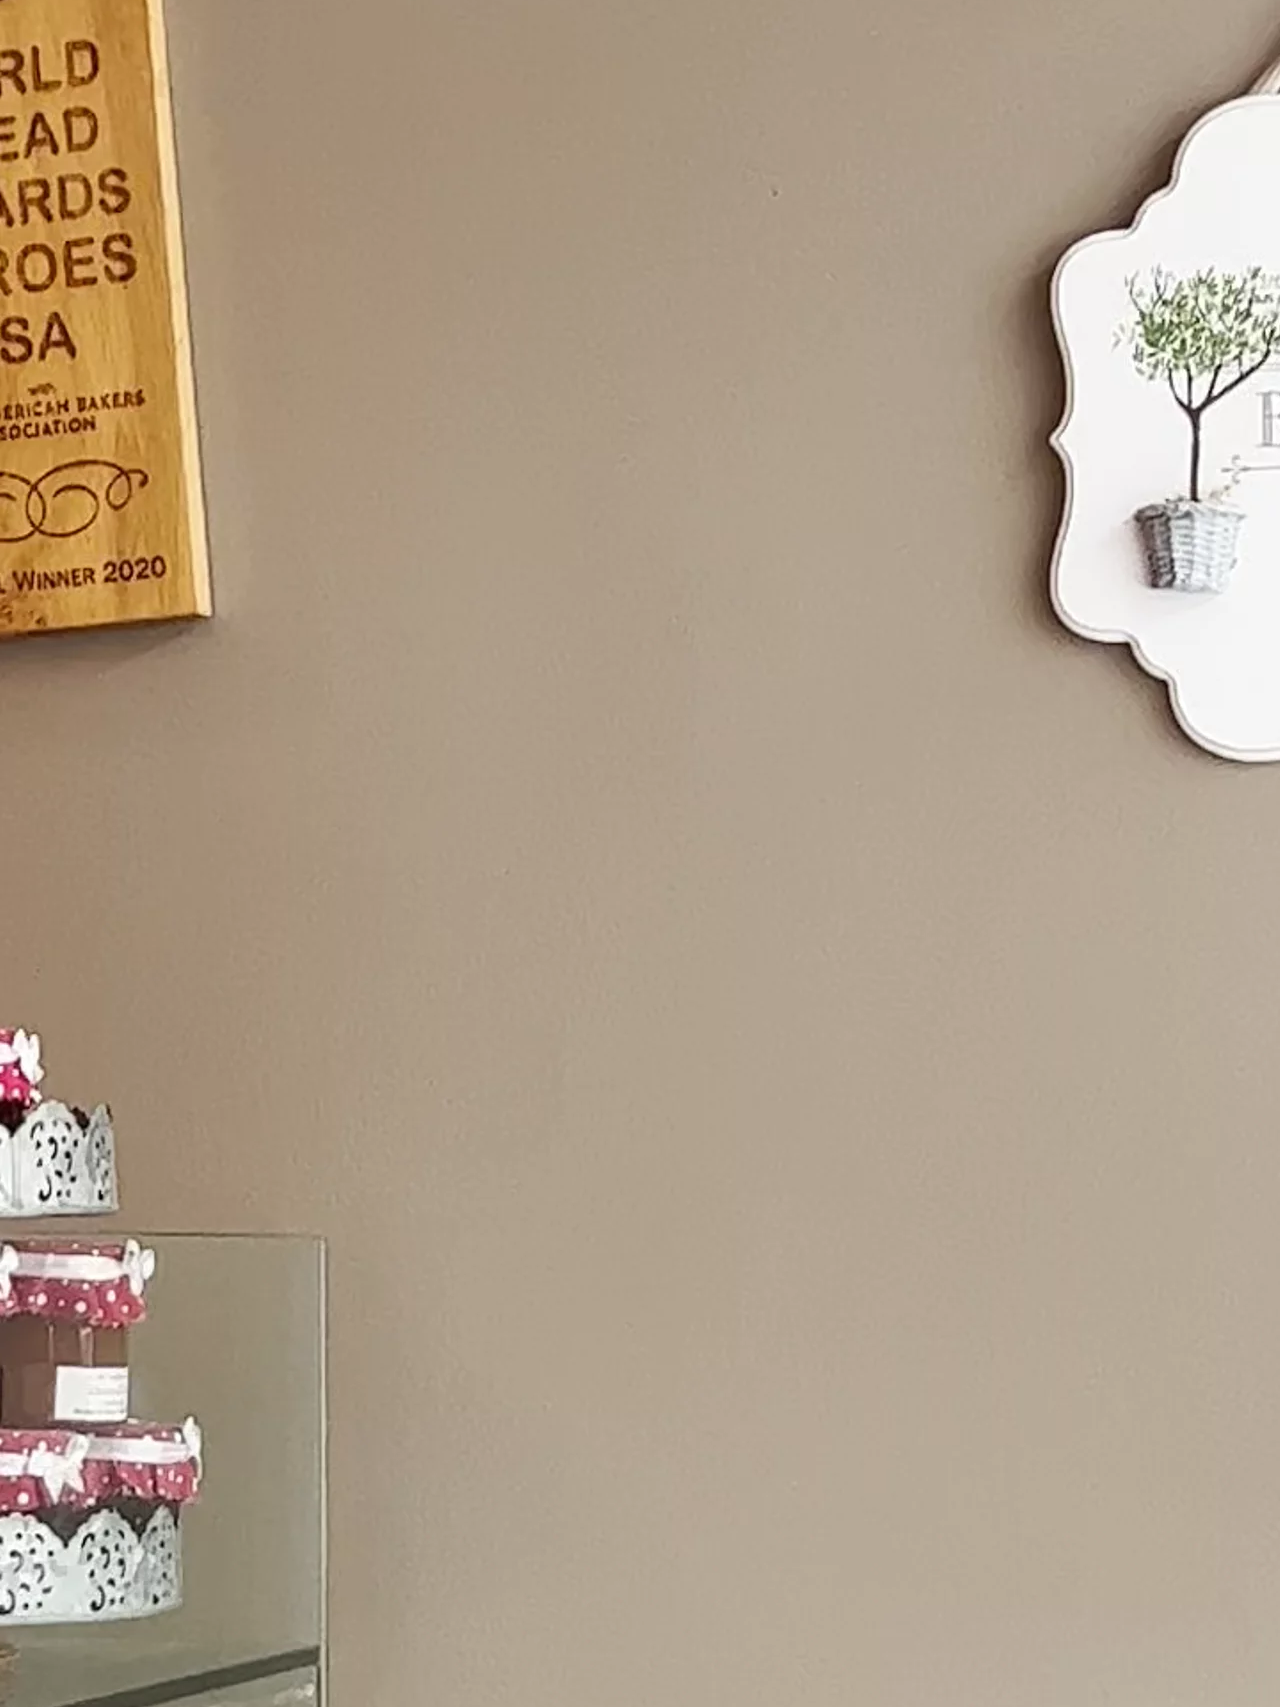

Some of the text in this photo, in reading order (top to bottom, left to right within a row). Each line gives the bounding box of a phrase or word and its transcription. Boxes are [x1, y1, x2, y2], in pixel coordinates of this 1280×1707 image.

[76, 389, 146, 413] BAKERS
[12, 567, 95, 592] WINNER
[103, 555, 167, 584] 2020
